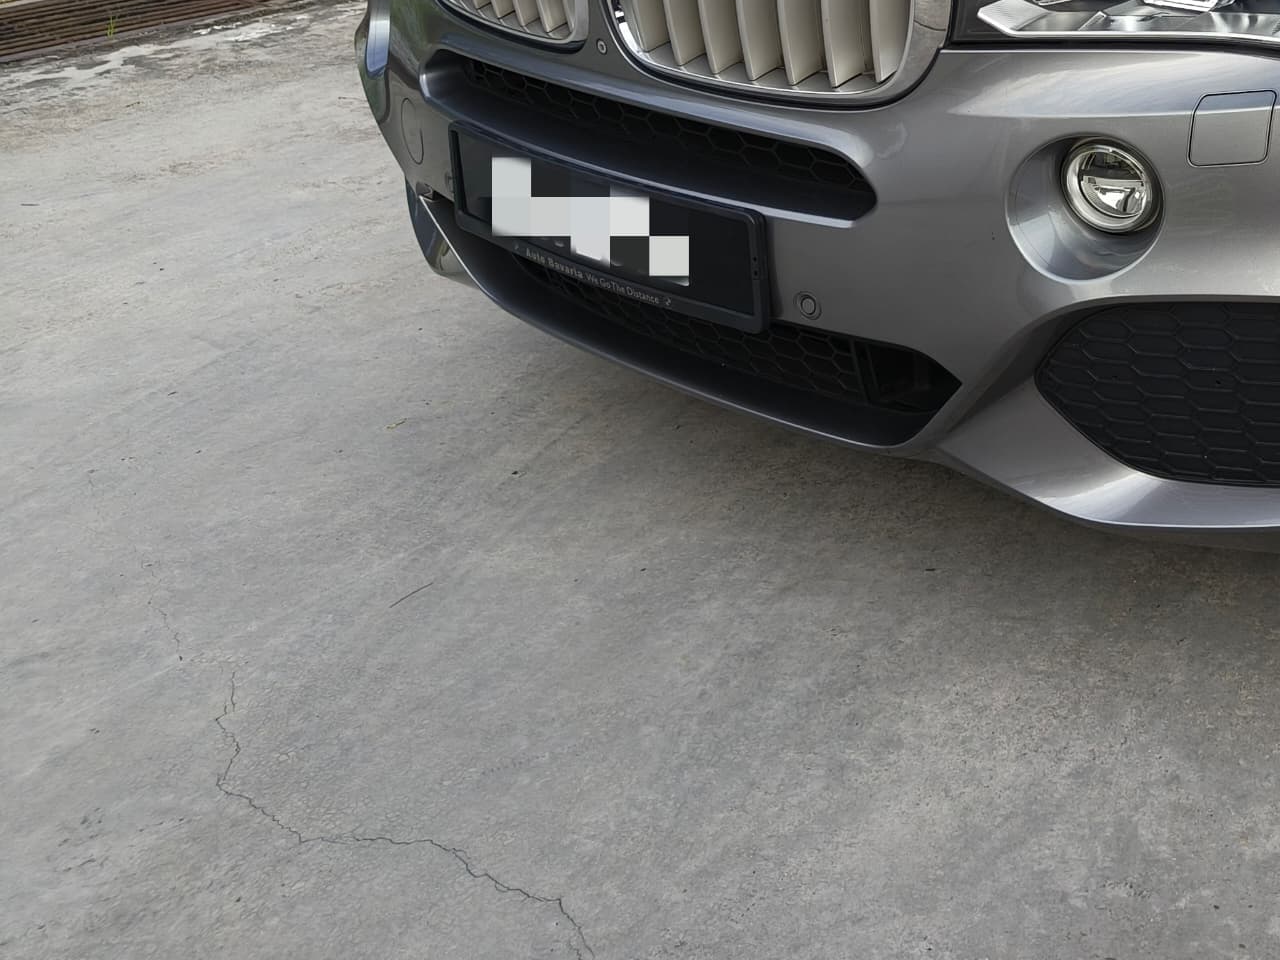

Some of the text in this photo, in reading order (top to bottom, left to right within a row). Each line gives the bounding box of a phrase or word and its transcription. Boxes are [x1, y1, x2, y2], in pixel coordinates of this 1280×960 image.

[526, 247, 546, 264] Auto
[584, 271, 599, 285] We
[599, 278, 611, 290] Go
[610, 280, 626, 295] The
[625, 286, 660, 304] Distance
